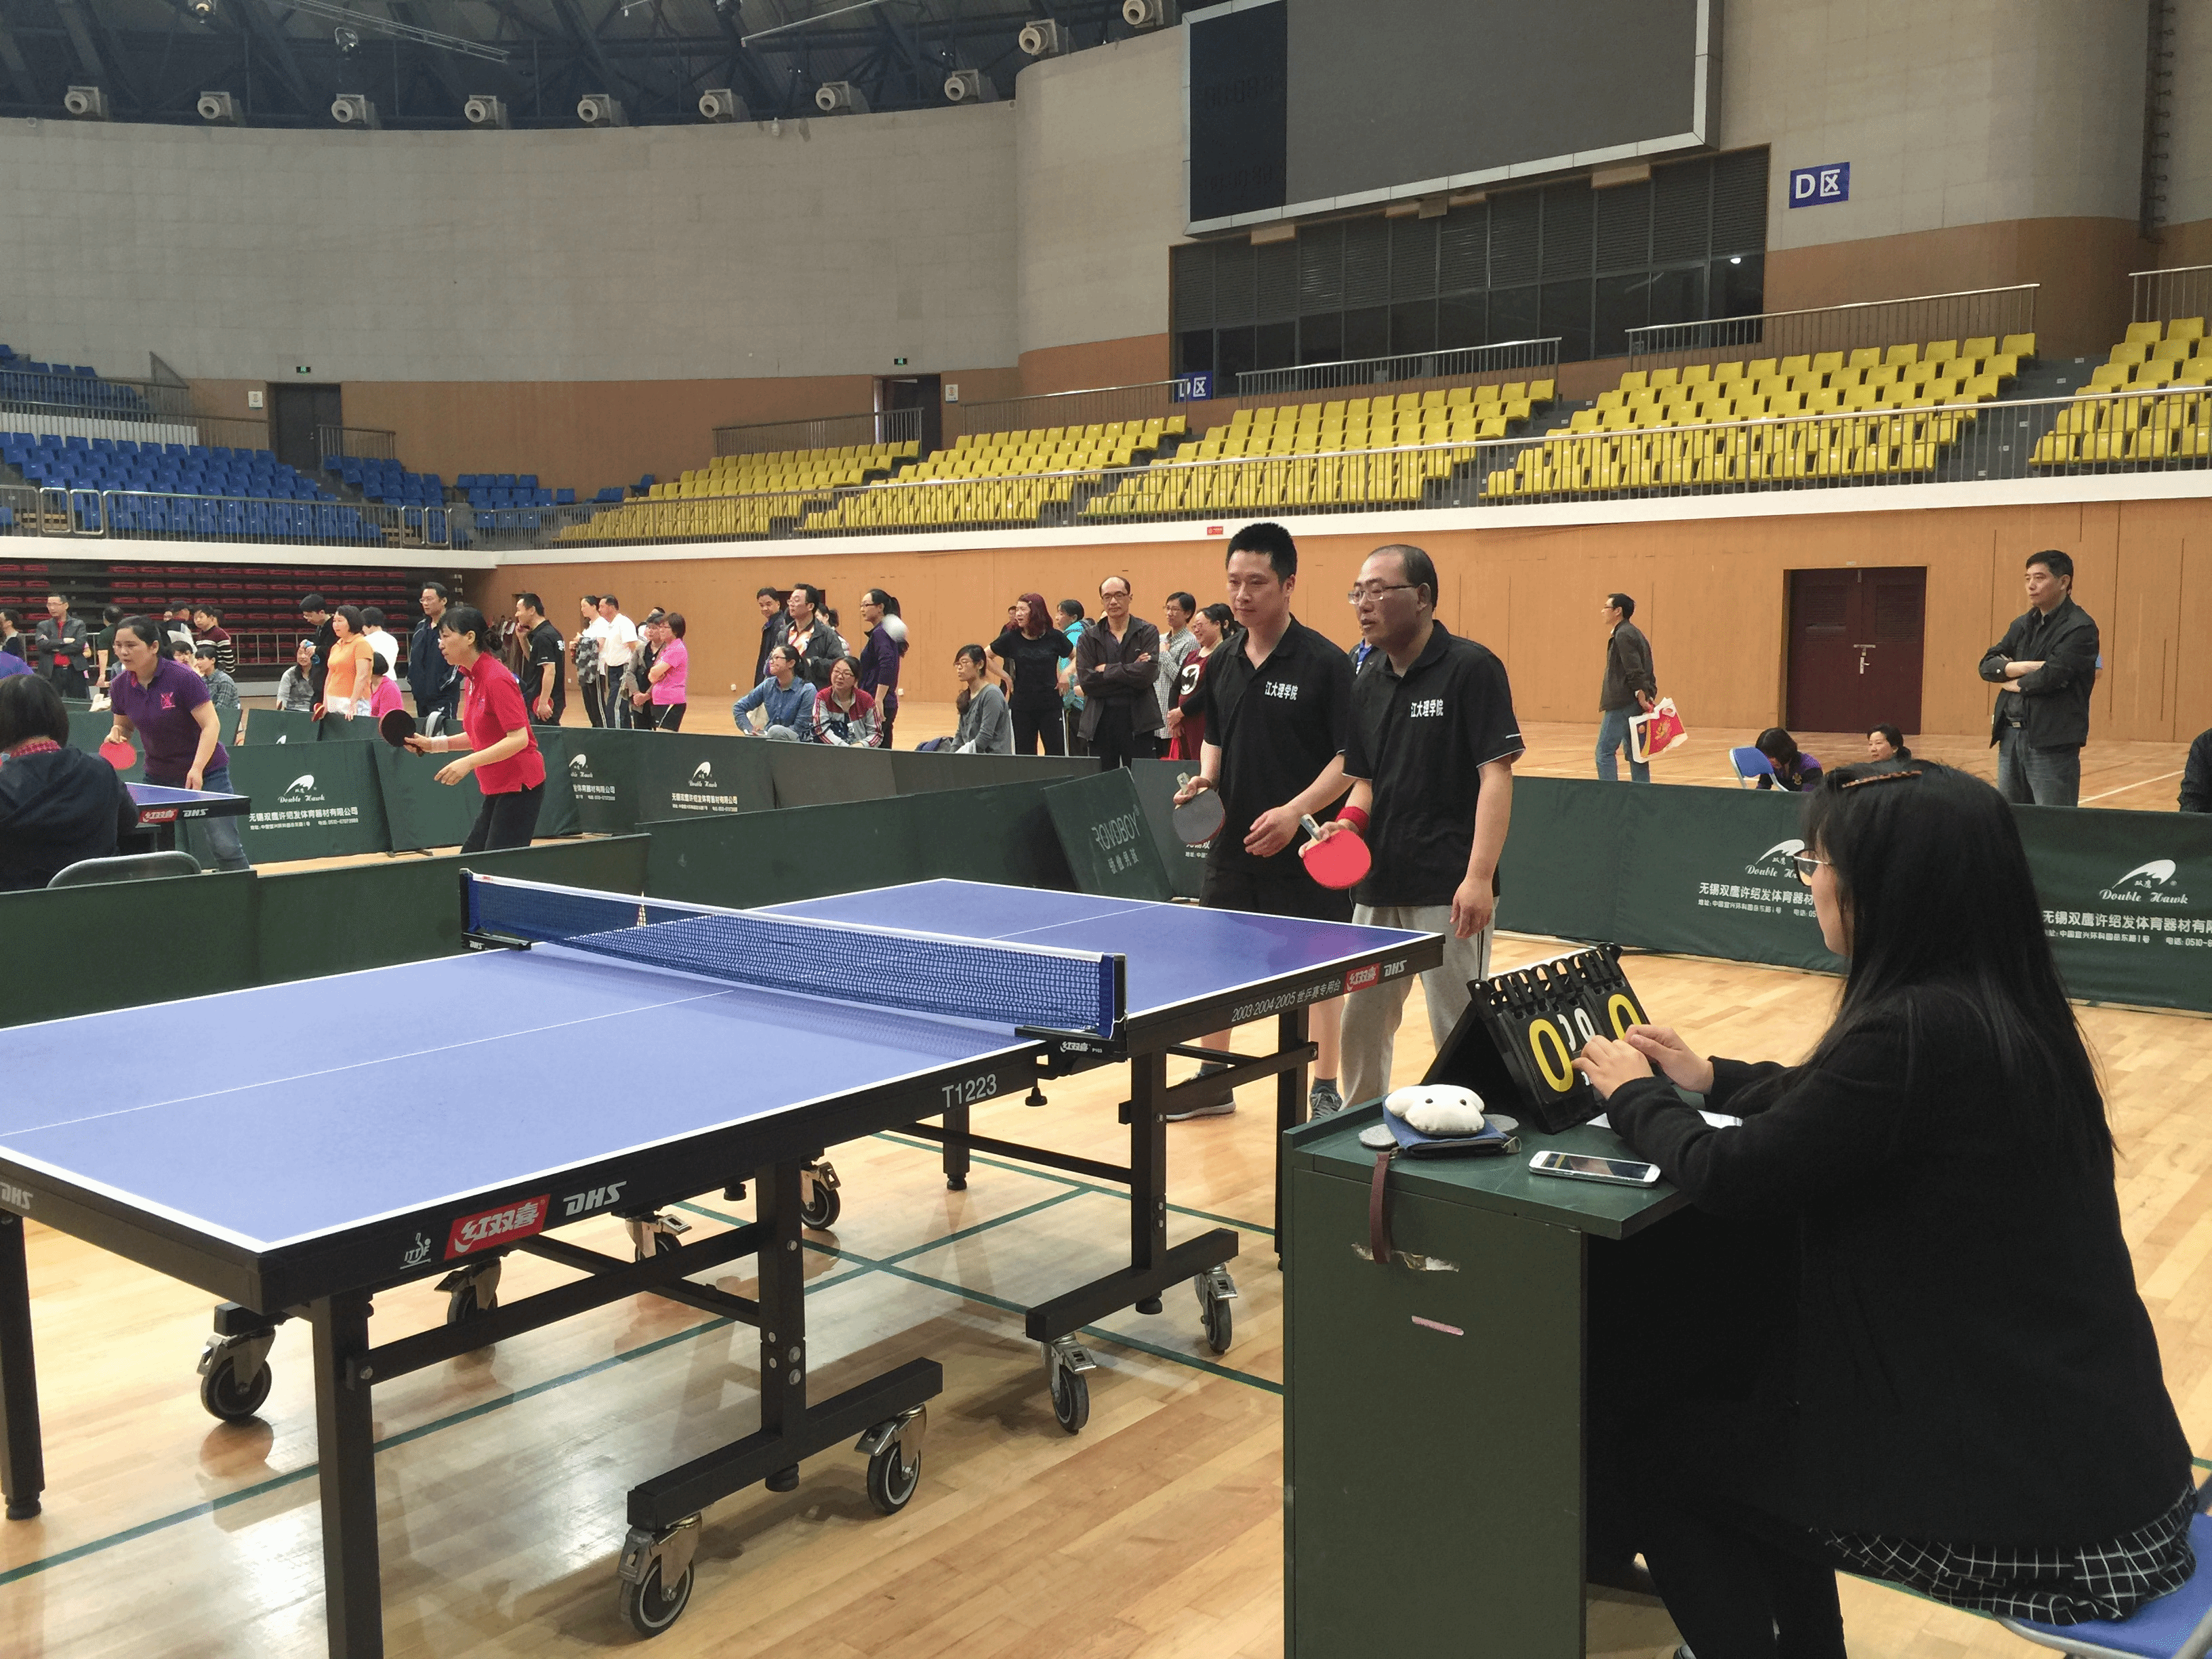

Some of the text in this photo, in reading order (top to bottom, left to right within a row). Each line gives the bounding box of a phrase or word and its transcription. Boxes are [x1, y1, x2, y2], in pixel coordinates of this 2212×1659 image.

[1265, 681, 1298, 701] 江大理学院
[1410, 699, 1443, 718] 江大理学院
[182, 808, 209, 817] DHS
[1745, 864, 1798, 879] Double Ha
[2100, 888, 2188, 904] Double Hawk
[1383, 960, 1408, 977] DHS
[942, 1073, 997, 1108] T1223
[0, 1181, 33, 1210] DHS
[562, 1181, 628, 1216] DHS
[455, 1202, 539, 1253] 红双喜
